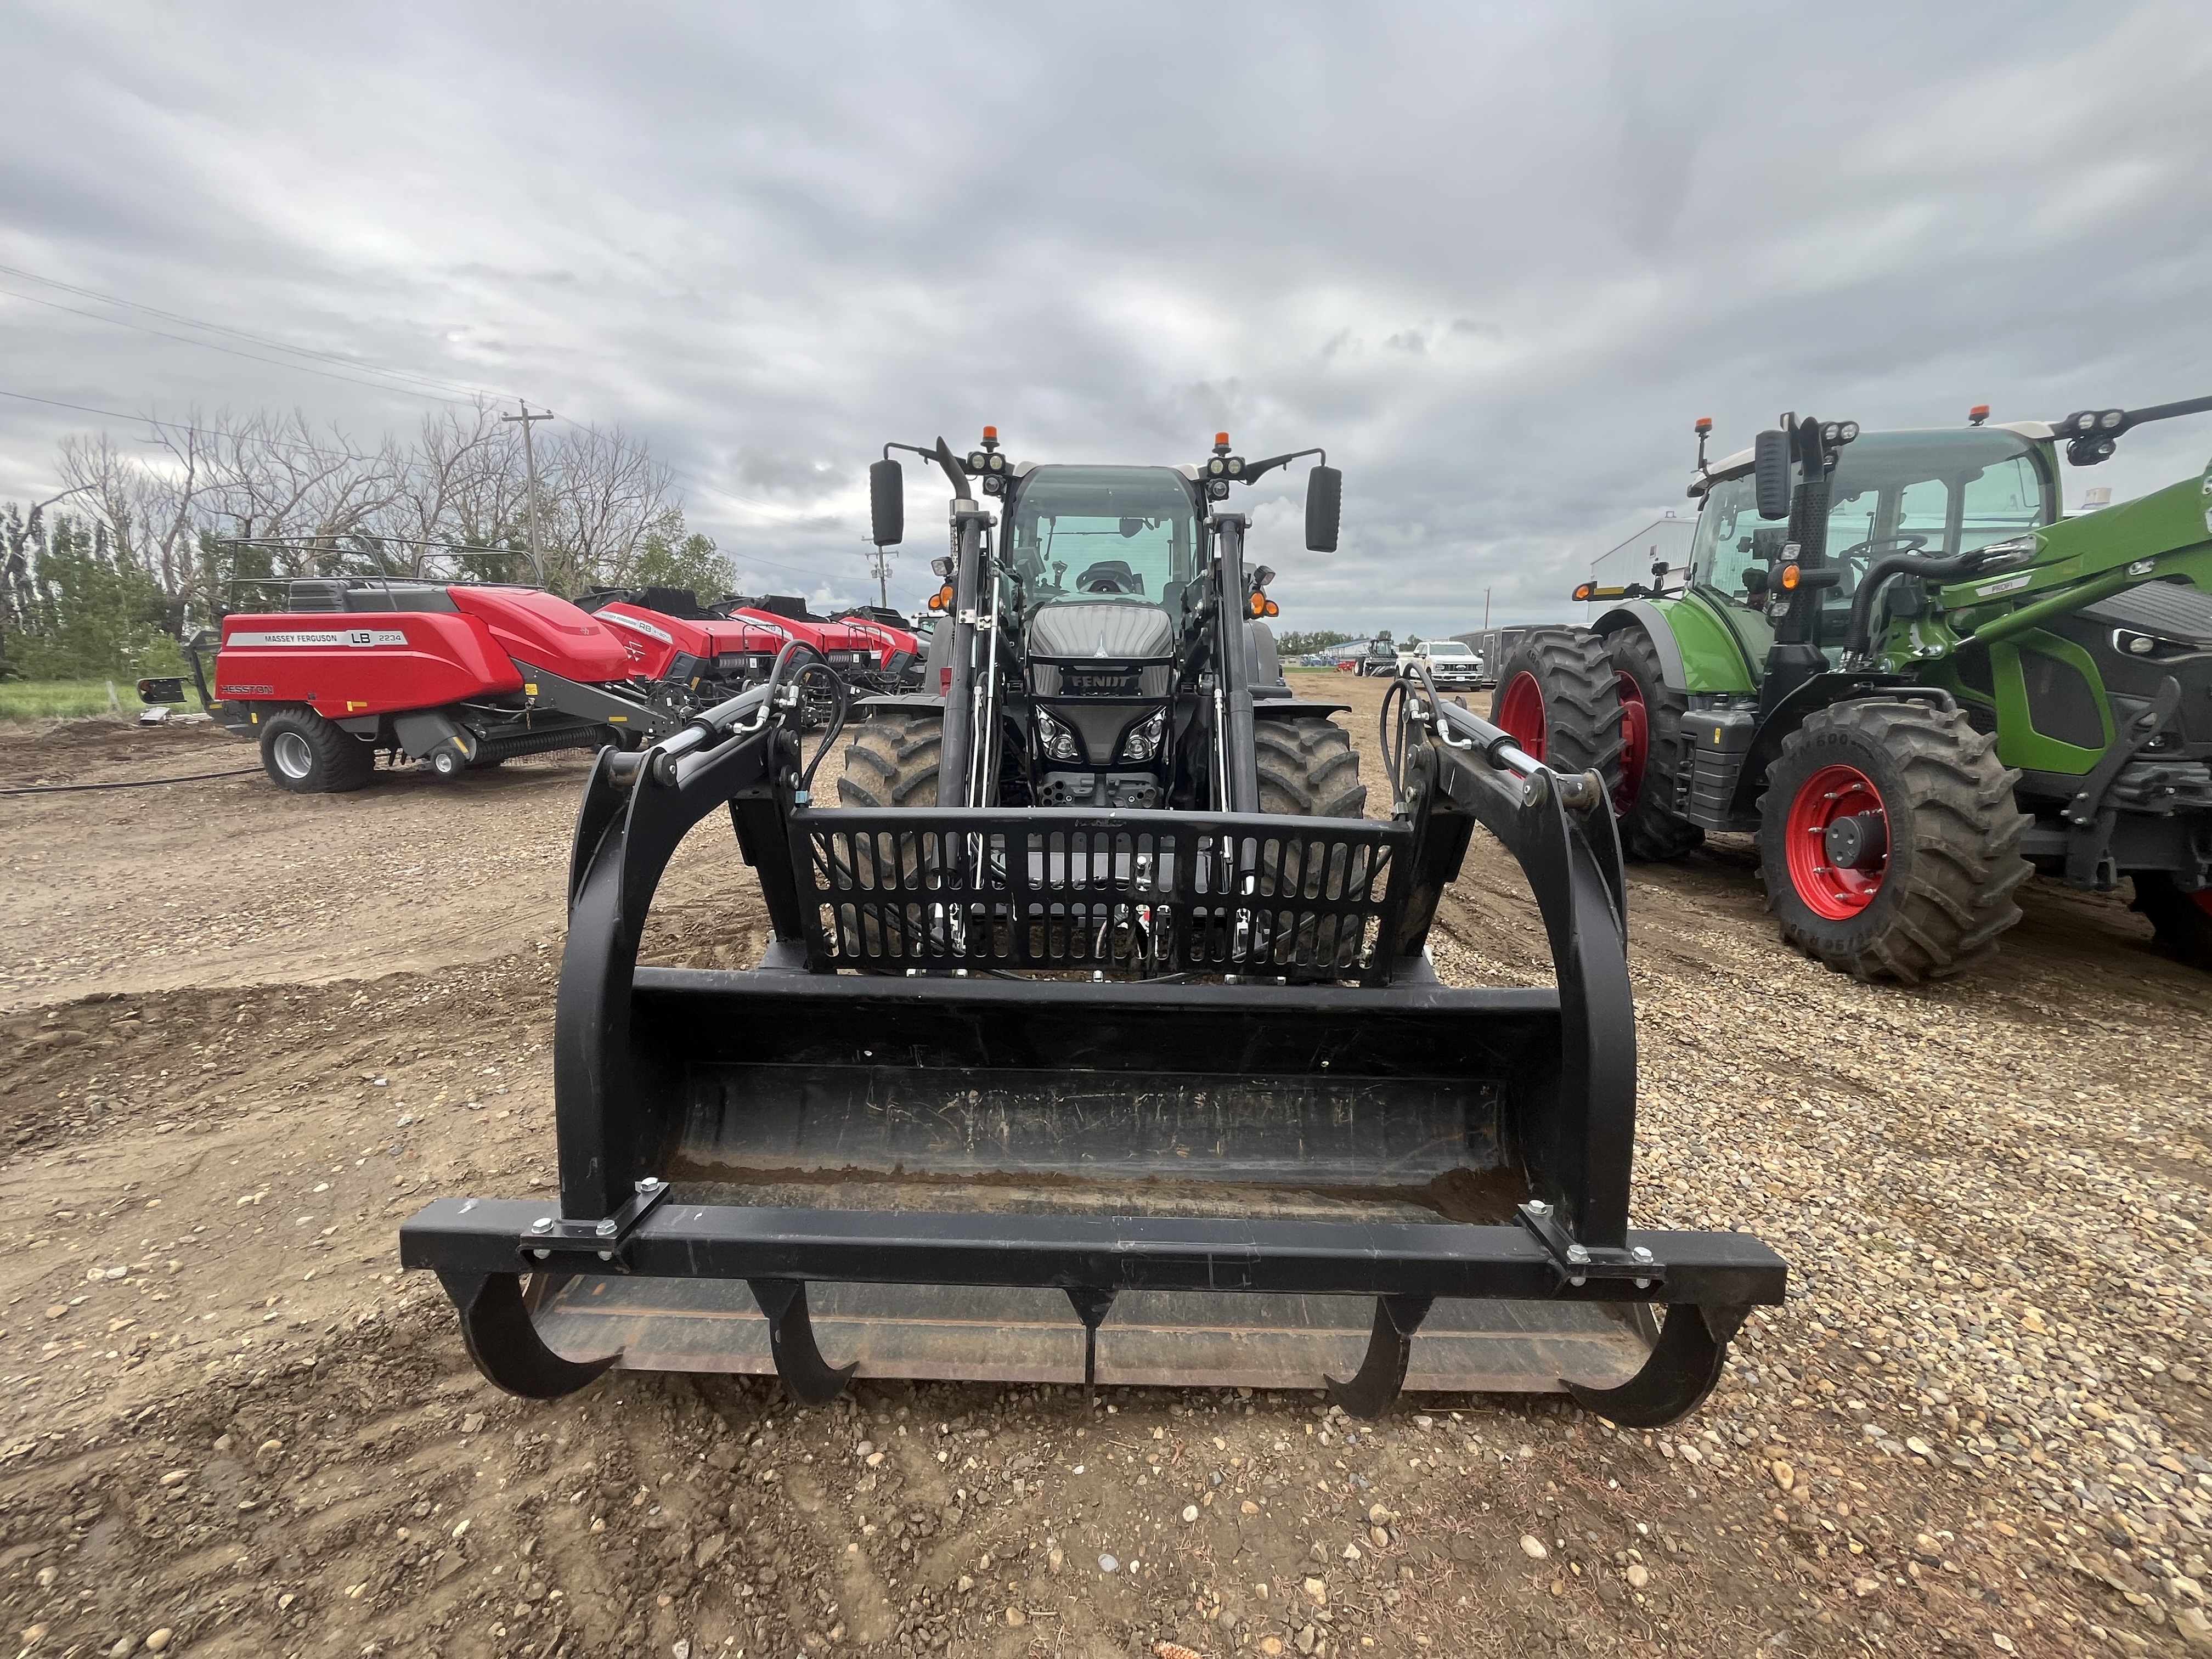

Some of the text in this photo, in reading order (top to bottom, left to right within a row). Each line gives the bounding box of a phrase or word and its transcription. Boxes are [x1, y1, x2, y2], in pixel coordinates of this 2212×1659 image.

[1992, 582, 2012, 592] PROFI
[639, 622, 652, 633] RB
[351, 633, 370, 644] LB
[1071, 676, 1130, 687] FENDT
[221, 685, 274, 694] HESSTON
